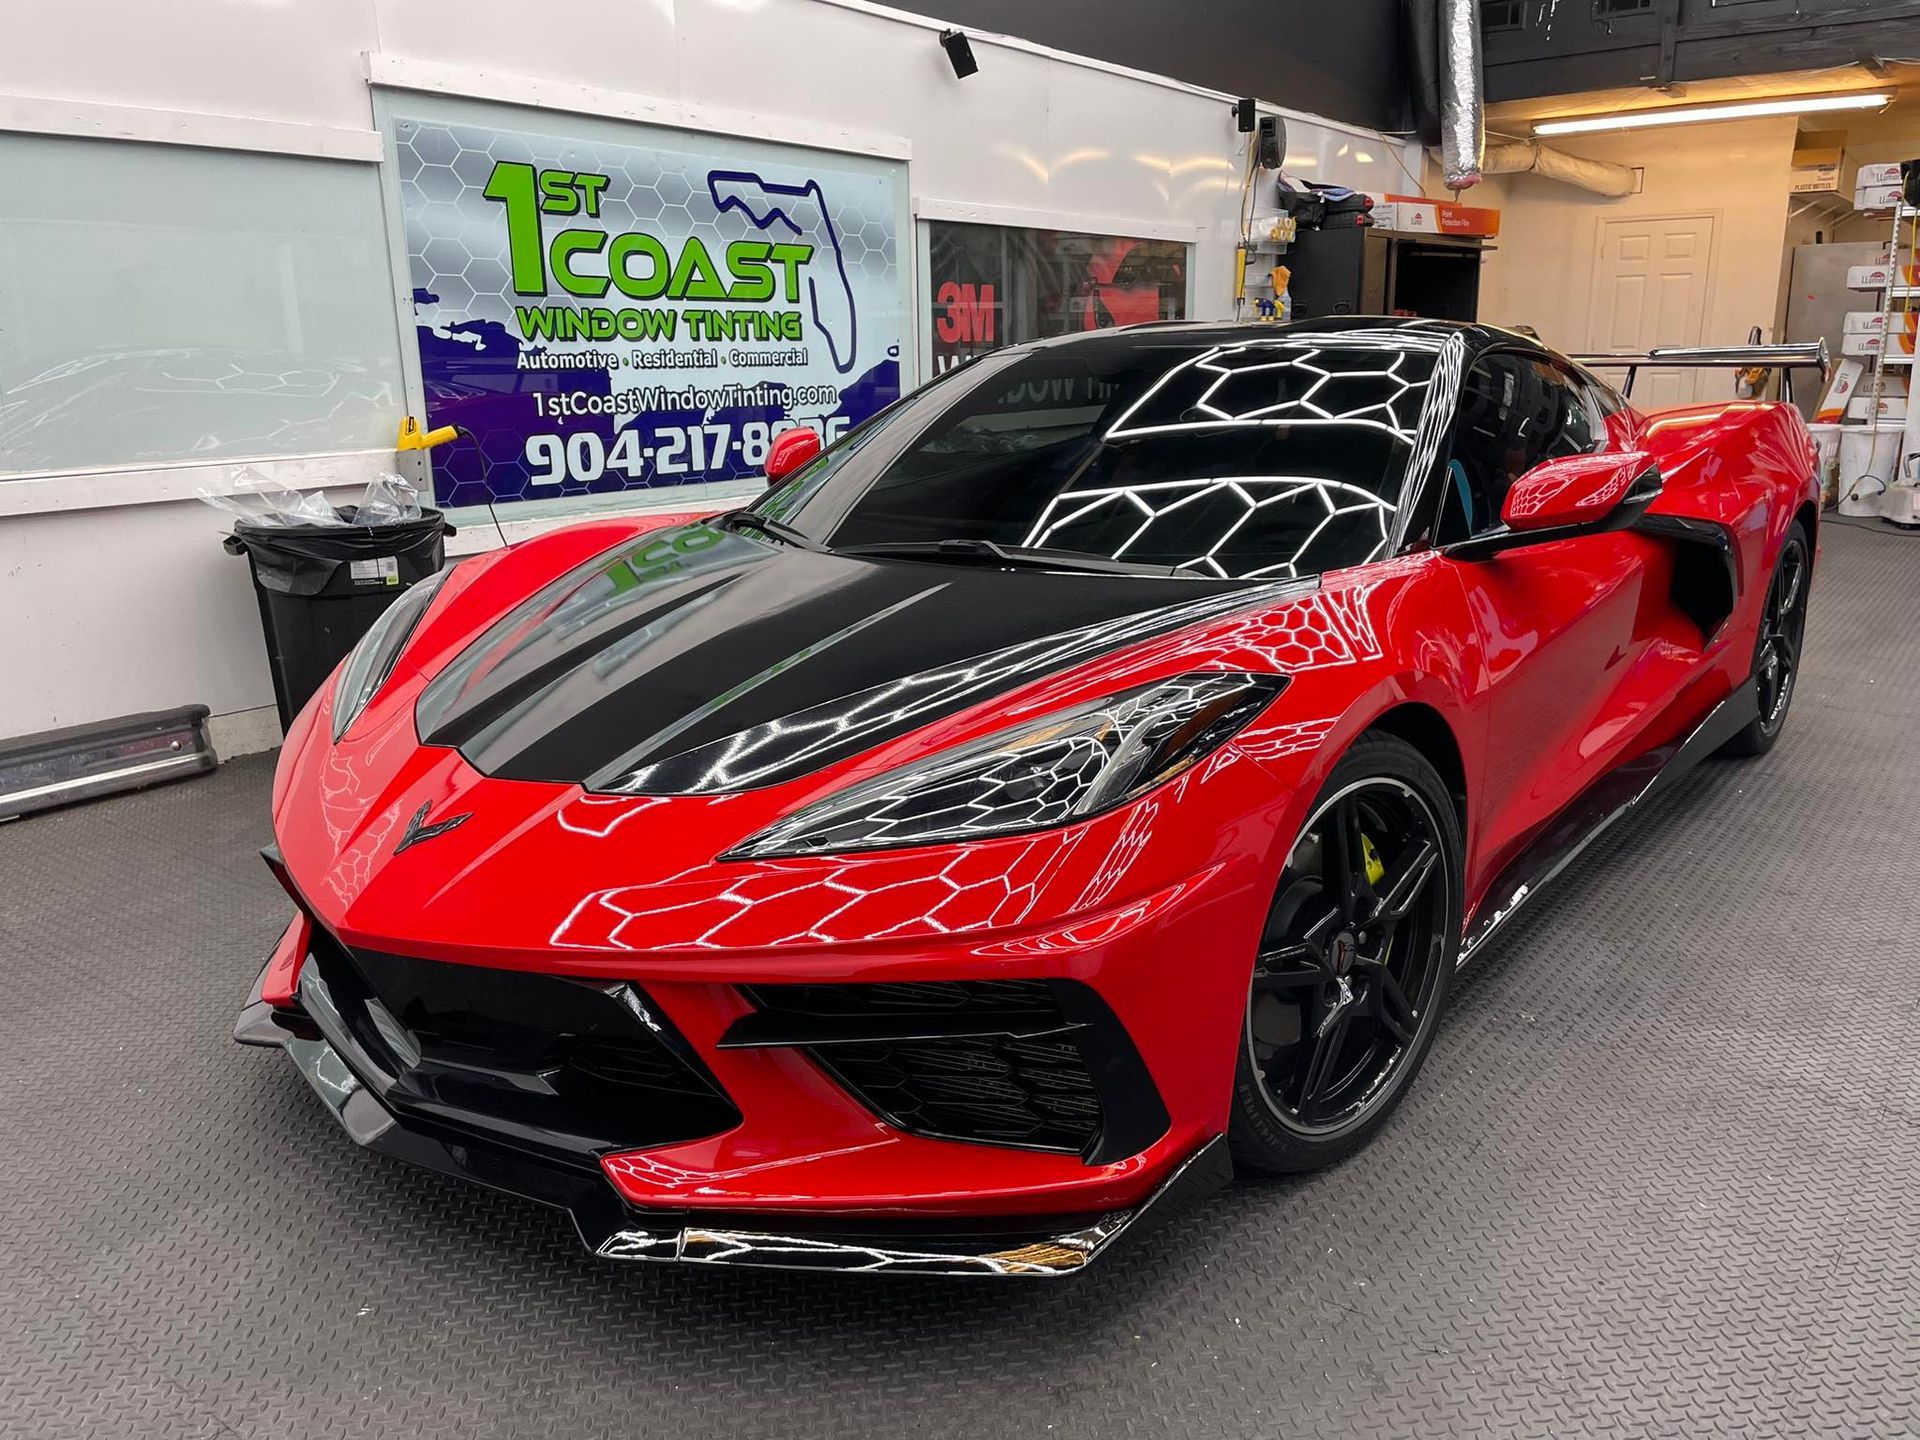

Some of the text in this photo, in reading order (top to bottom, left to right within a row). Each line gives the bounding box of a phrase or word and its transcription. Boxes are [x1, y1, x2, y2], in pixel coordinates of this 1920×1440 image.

[482, 160, 611, 297] 1ST
[549, 229, 814, 303] COAST
[515, 307, 803, 341] WINDOW TINTING
[936, 280, 995, 343] 3M
[516, 348, 808, 369] Automotive Residential Commercial
[532, 384, 837, 417] 1stCoastWindowTinting.com
